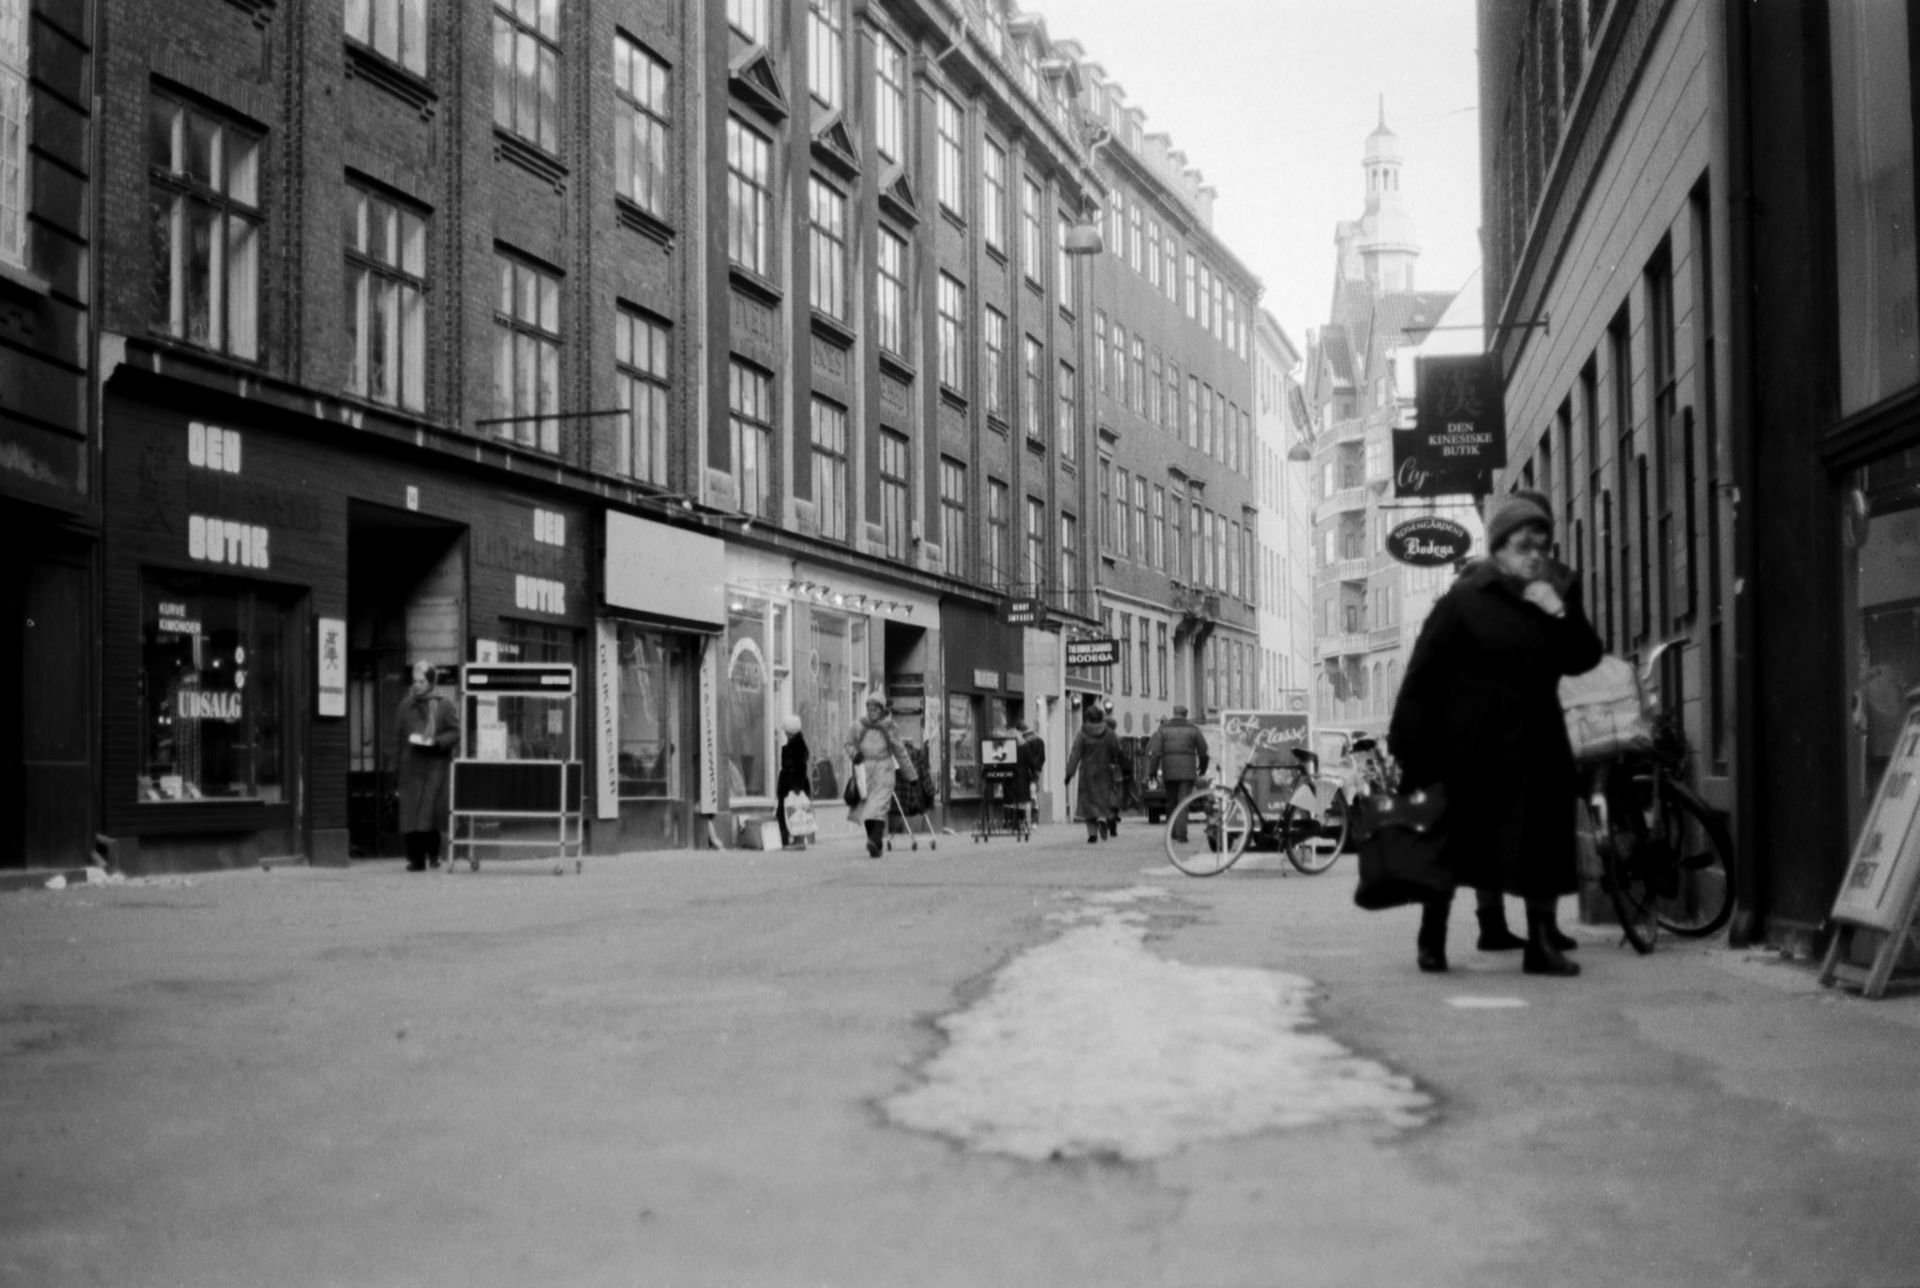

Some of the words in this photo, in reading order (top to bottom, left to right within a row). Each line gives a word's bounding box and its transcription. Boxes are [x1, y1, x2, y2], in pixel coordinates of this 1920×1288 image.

[1447, 422, 1474, 433] DEN
[188, 421, 242, 474] DEN
[1429, 433, 1492, 446] KINESISKE
[1443, 445, 1480, 457] BUTIK
[1395, 518, 1466, 539] ROSENGÅRDENS
[188, 515, 269, 569] BUTIK
[1403, 536, 1455, 560] Bodega
[515, 574, 566, 615] BUTIK
[159, 602, 186, 617] KURVE
[159, 618, 201, 634] KIMONOER
[1068, 653, 1113, 663] BODEGA
[177, 691, 242, 719] UDSALG
[600, 643, 616, 795] DELIKATESSER
